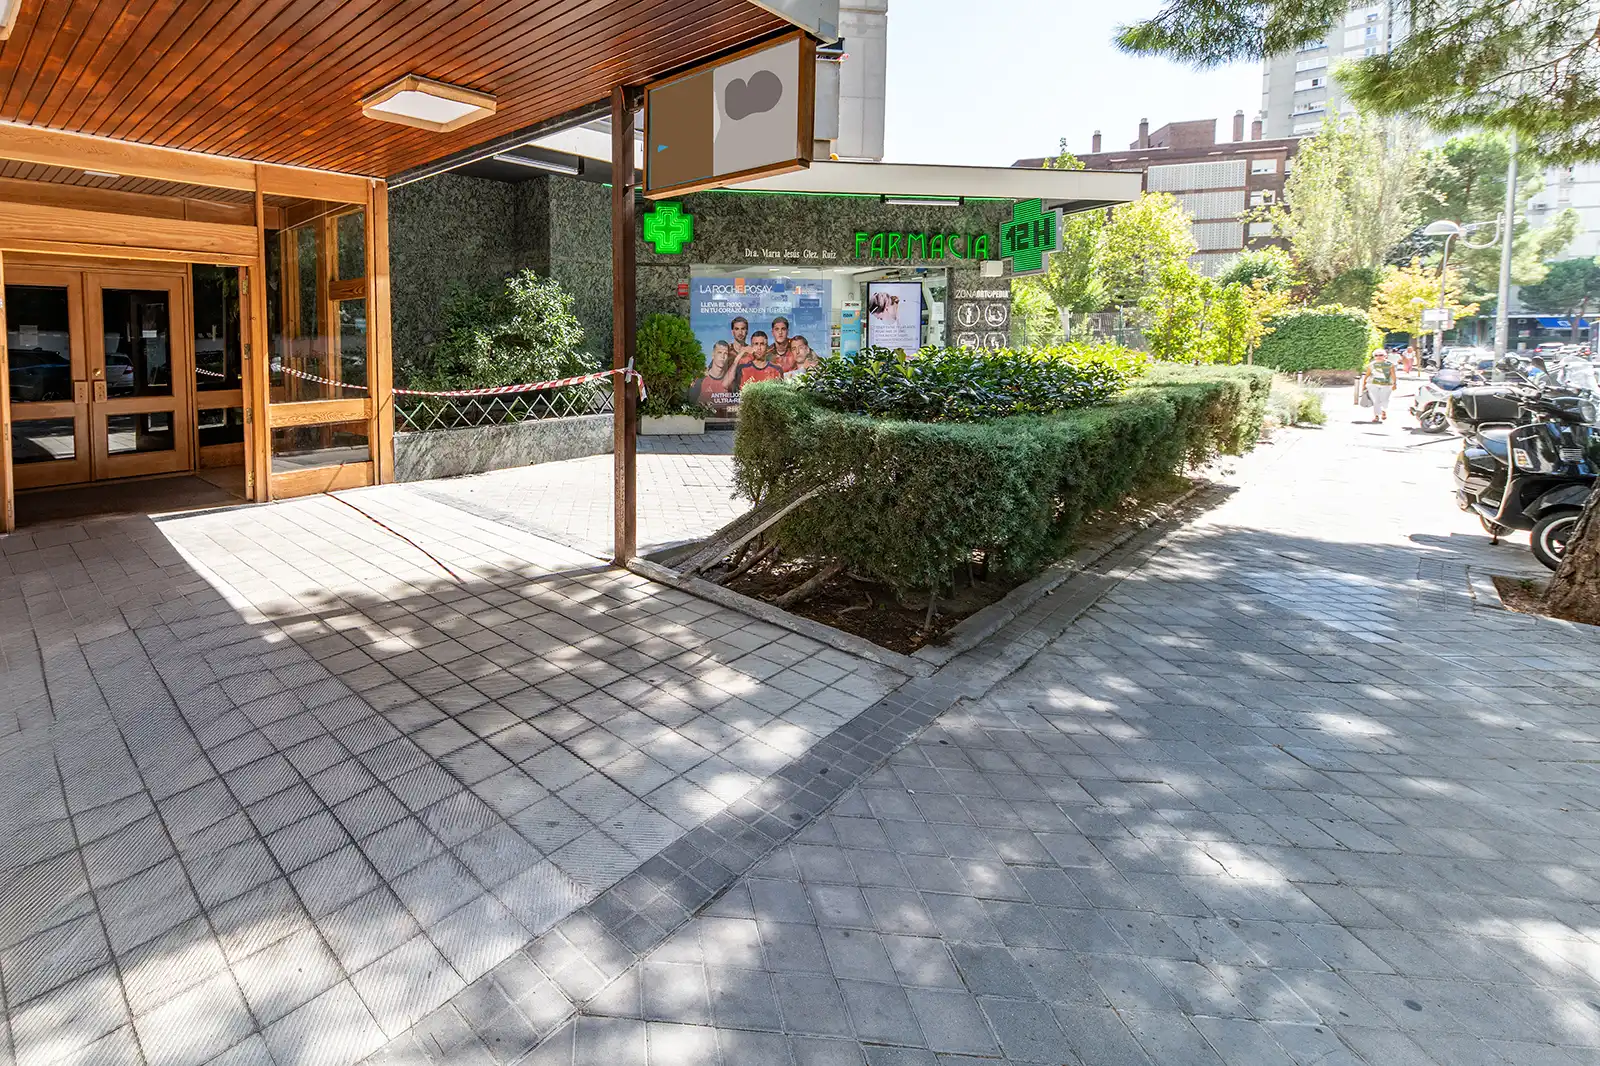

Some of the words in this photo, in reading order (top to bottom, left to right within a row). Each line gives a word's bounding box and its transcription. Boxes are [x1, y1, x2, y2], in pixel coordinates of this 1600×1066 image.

[855, 231, 990, 259] FARMACIA
[822, 249, 837, 259] Ruiz
[699, 284, 712, 294] LA
